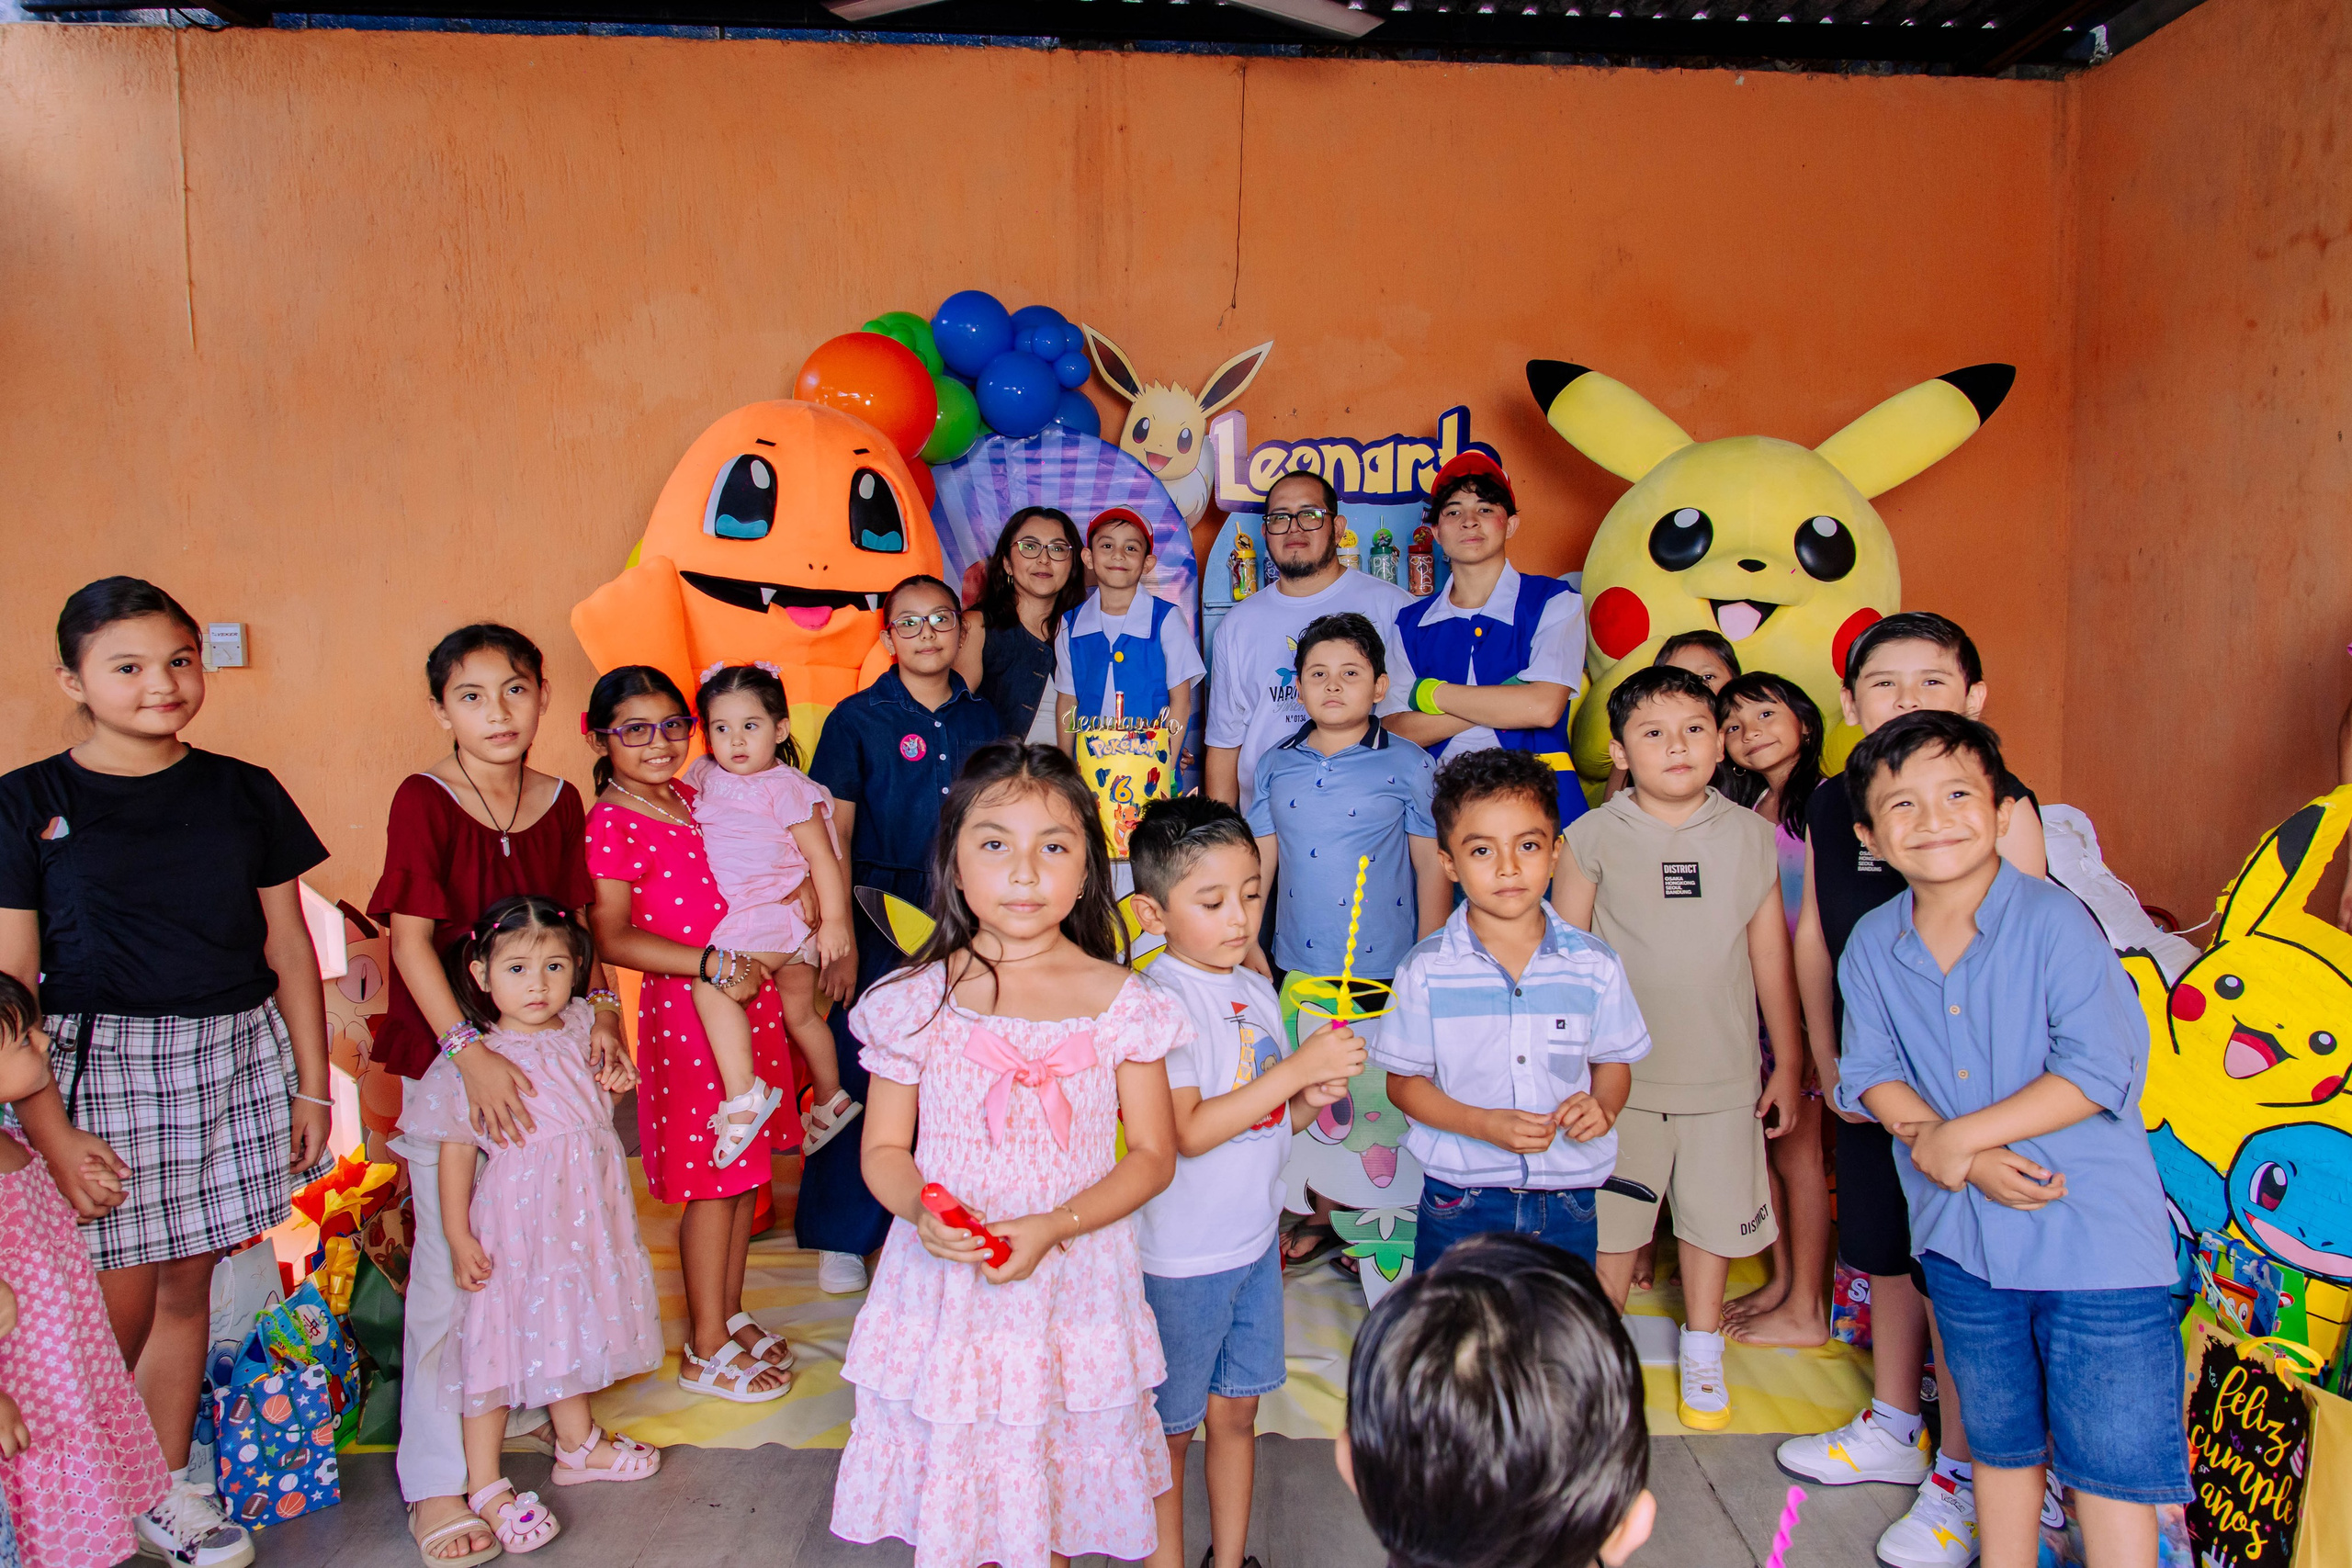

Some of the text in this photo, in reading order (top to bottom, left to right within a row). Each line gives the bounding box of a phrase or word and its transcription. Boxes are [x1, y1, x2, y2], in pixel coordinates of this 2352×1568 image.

[1210, 405, 1501, 513] Leonard
[1062, 705, 1183, 736] Leonardo
[1269, 685, 1299, 702] VAPO
[1114, 775, 1134, 804] 6
[1664, 864, 1697, 874] DISTRICT
[2212, 1365, 2291, 1467] feliz
[2191, 1425, 2294, 1525] cumple
[2200, 1482, 2267, 1561] años
